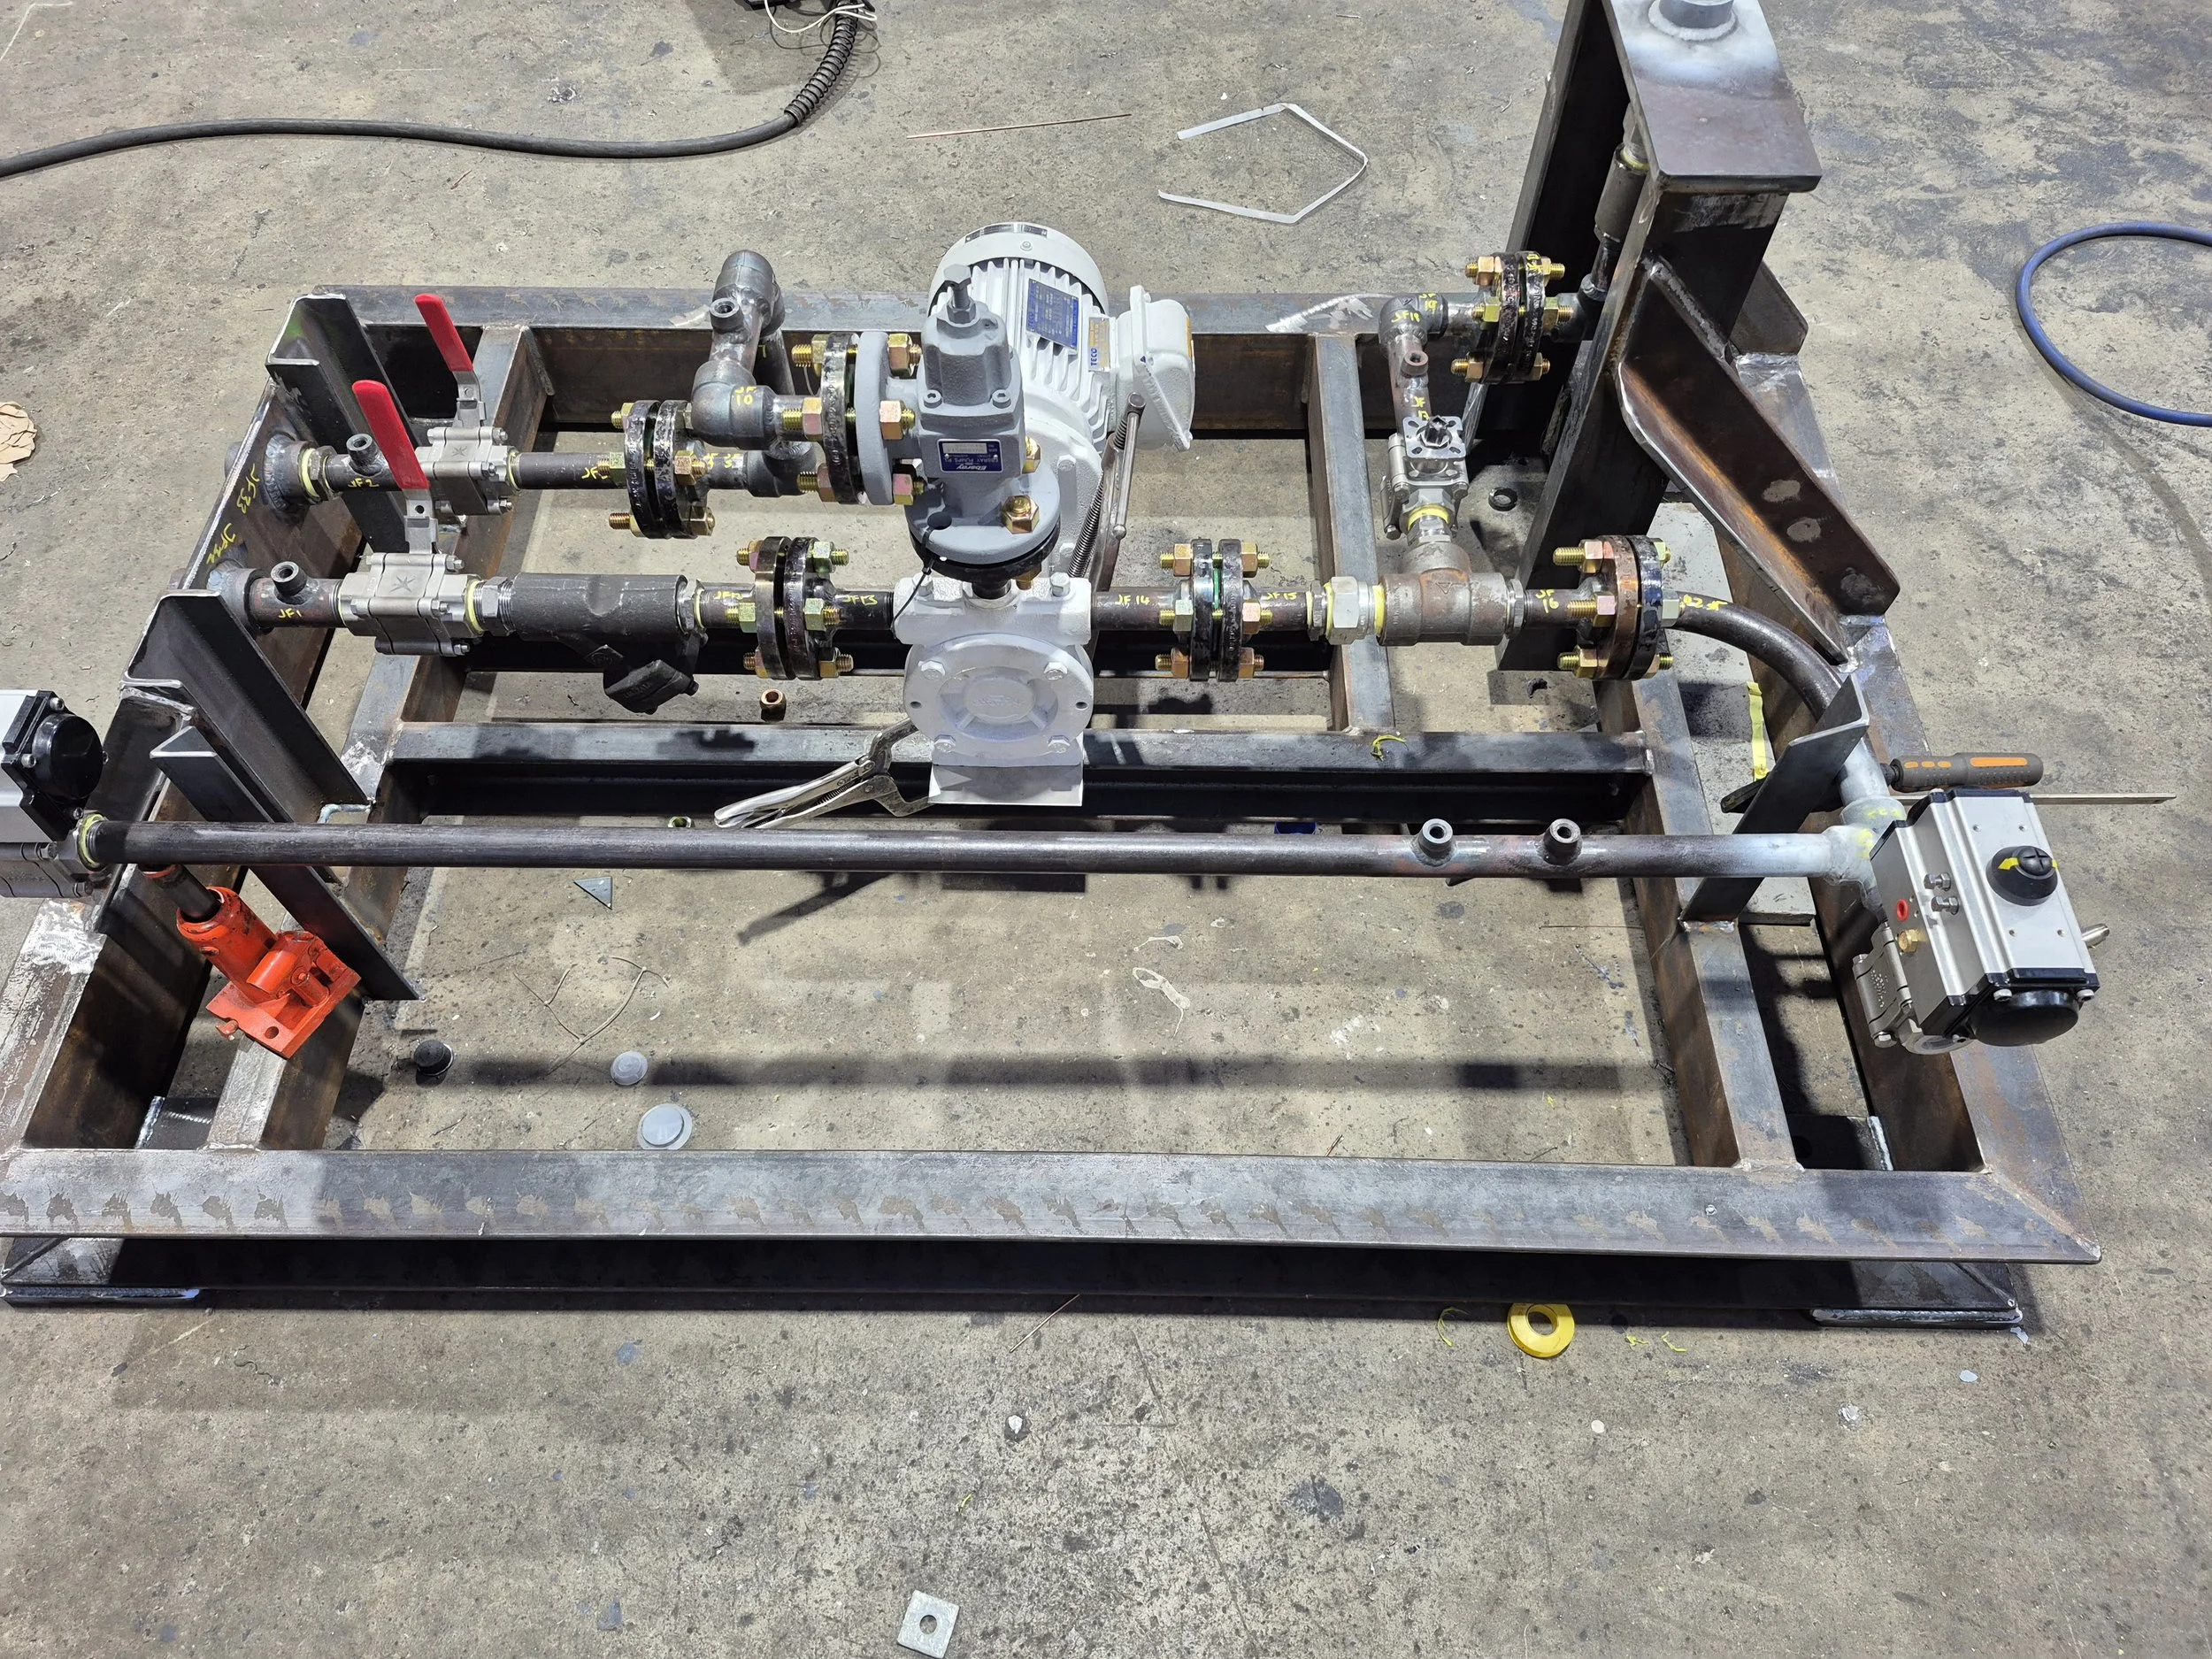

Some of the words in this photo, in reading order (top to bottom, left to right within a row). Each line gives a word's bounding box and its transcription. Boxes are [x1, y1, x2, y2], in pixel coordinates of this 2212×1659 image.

[736, 394, 754, 407] 10
[236, 463, 260, 514] JF33
[1542, 597, 1560, 614] 16
